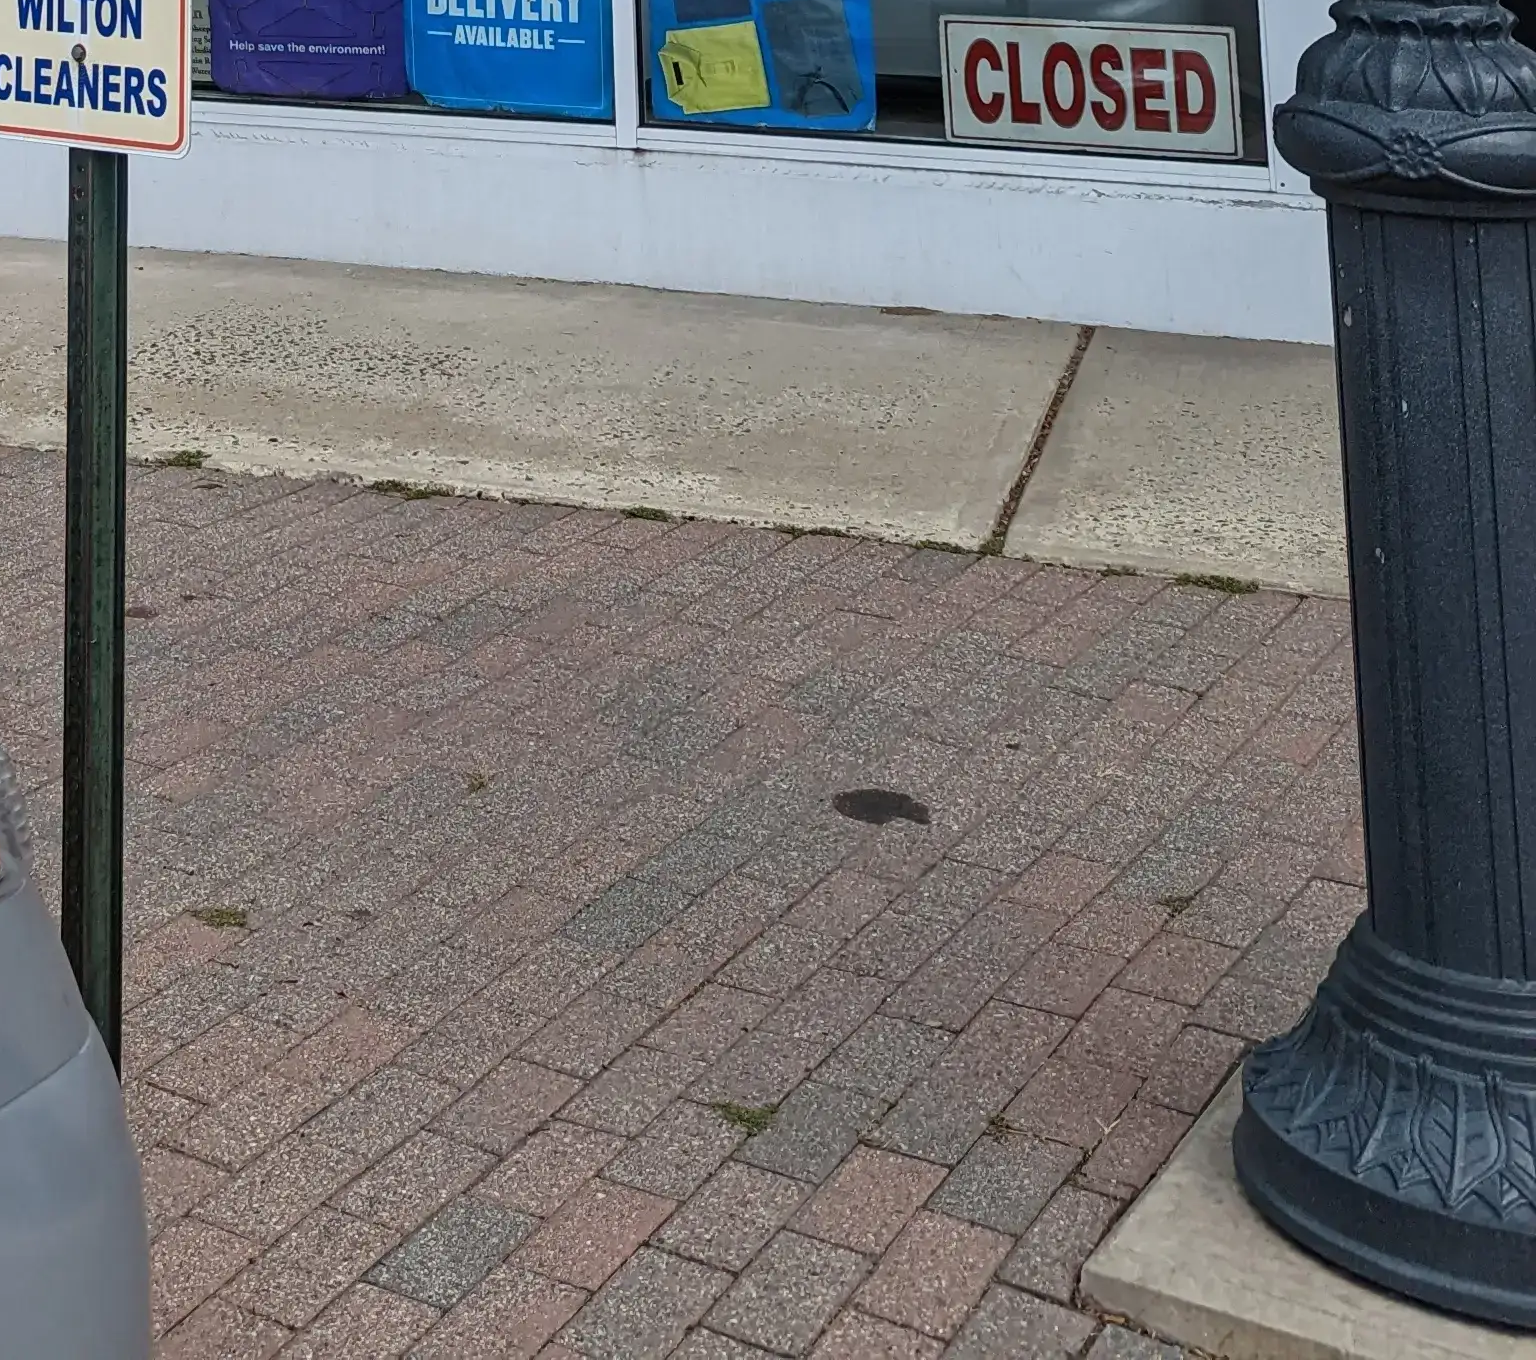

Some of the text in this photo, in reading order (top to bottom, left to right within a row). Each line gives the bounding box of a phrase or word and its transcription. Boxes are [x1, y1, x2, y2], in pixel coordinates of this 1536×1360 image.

[229, 40, 386, 55] Help save the environment!
[454, 25, 555, 51] AVAILABLE
[964, 37, 1216, 134] CLOSED
